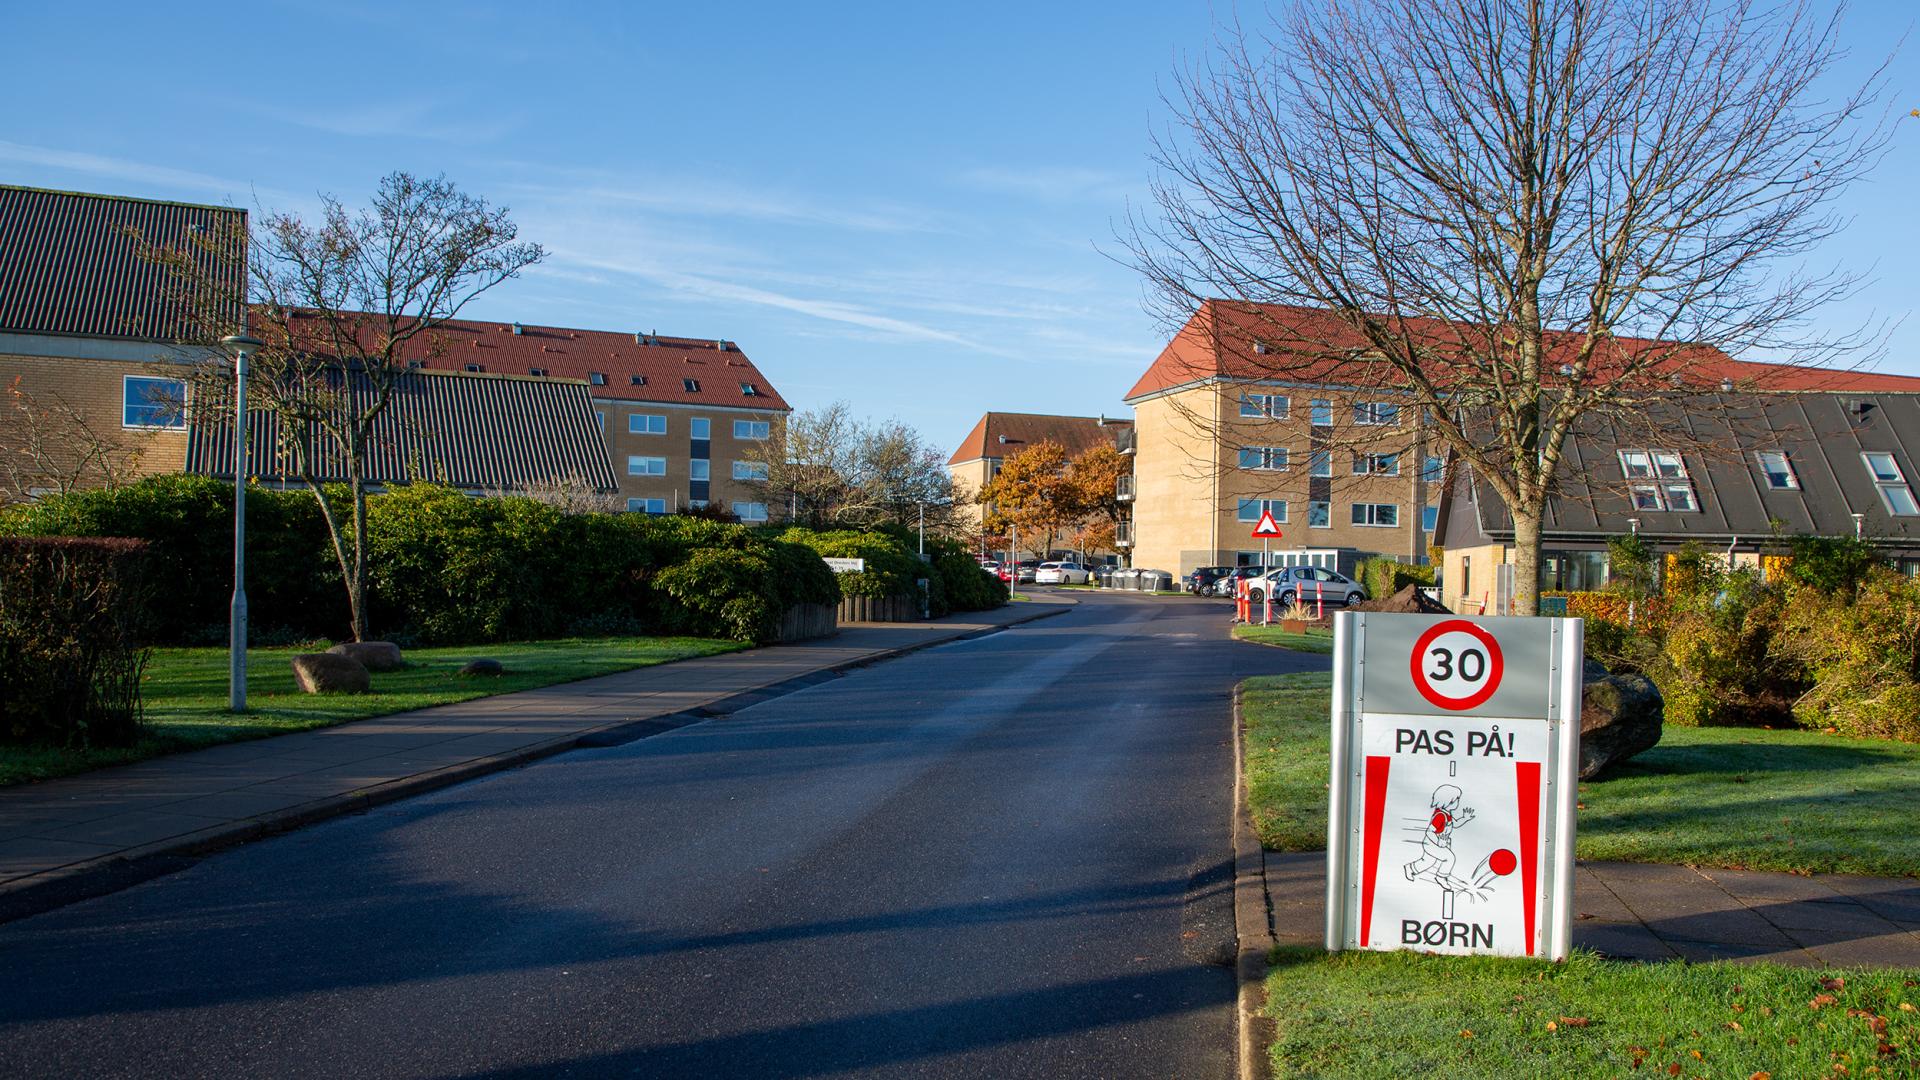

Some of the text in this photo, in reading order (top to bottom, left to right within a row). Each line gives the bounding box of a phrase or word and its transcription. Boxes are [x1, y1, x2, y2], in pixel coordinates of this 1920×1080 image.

[1429, 648, 1485, 682] 30
[1396, 725, 1514, 758] PAS PÅ!
[1401, 919, 1494, 949] BØRN
